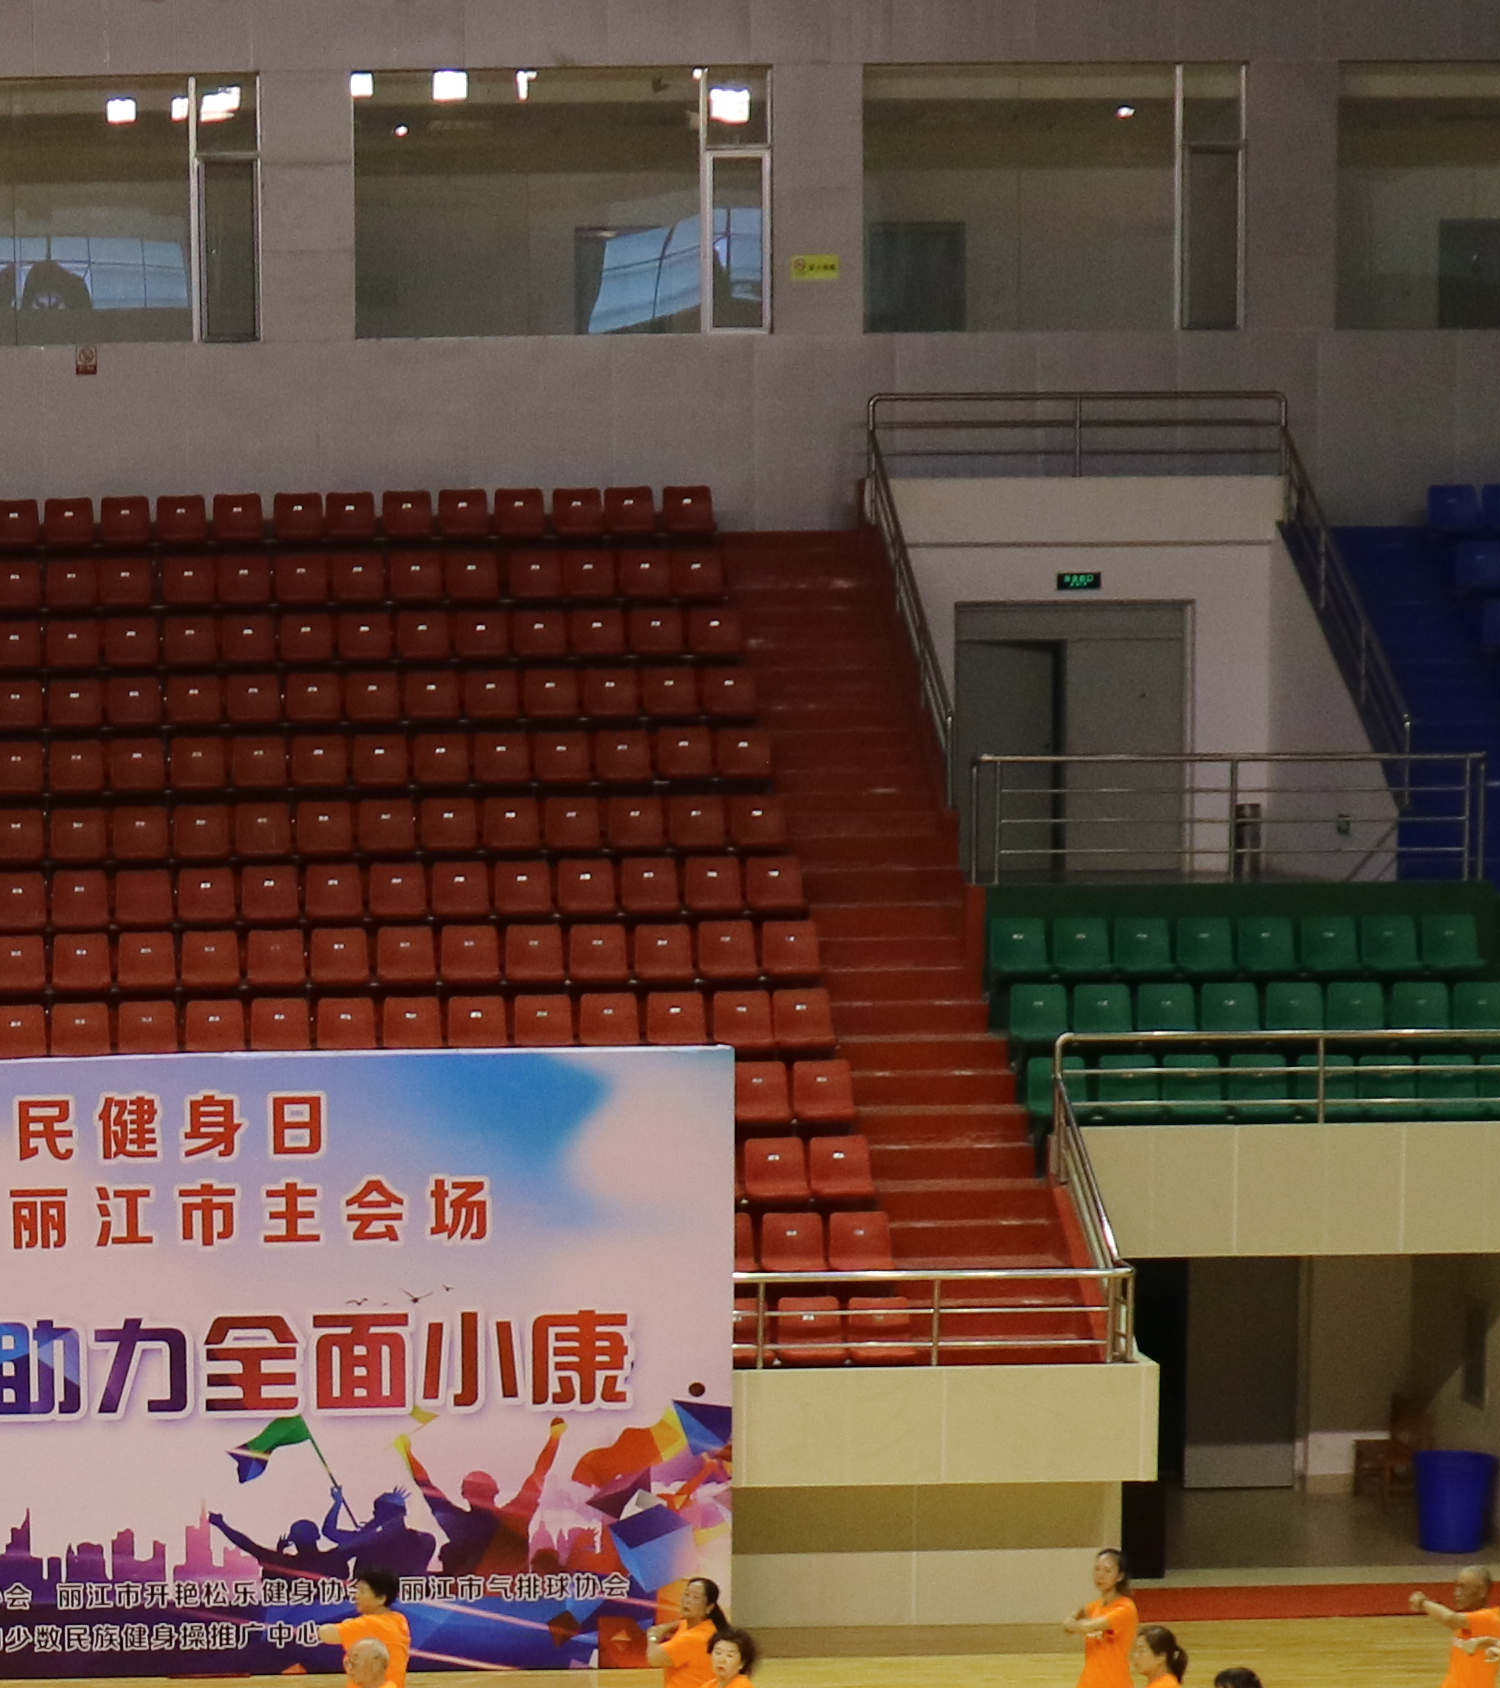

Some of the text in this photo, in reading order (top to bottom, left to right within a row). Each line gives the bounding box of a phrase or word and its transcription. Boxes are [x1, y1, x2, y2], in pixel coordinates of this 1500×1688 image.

[400, 1573, 630, 1602] 丽江市气排球协会
